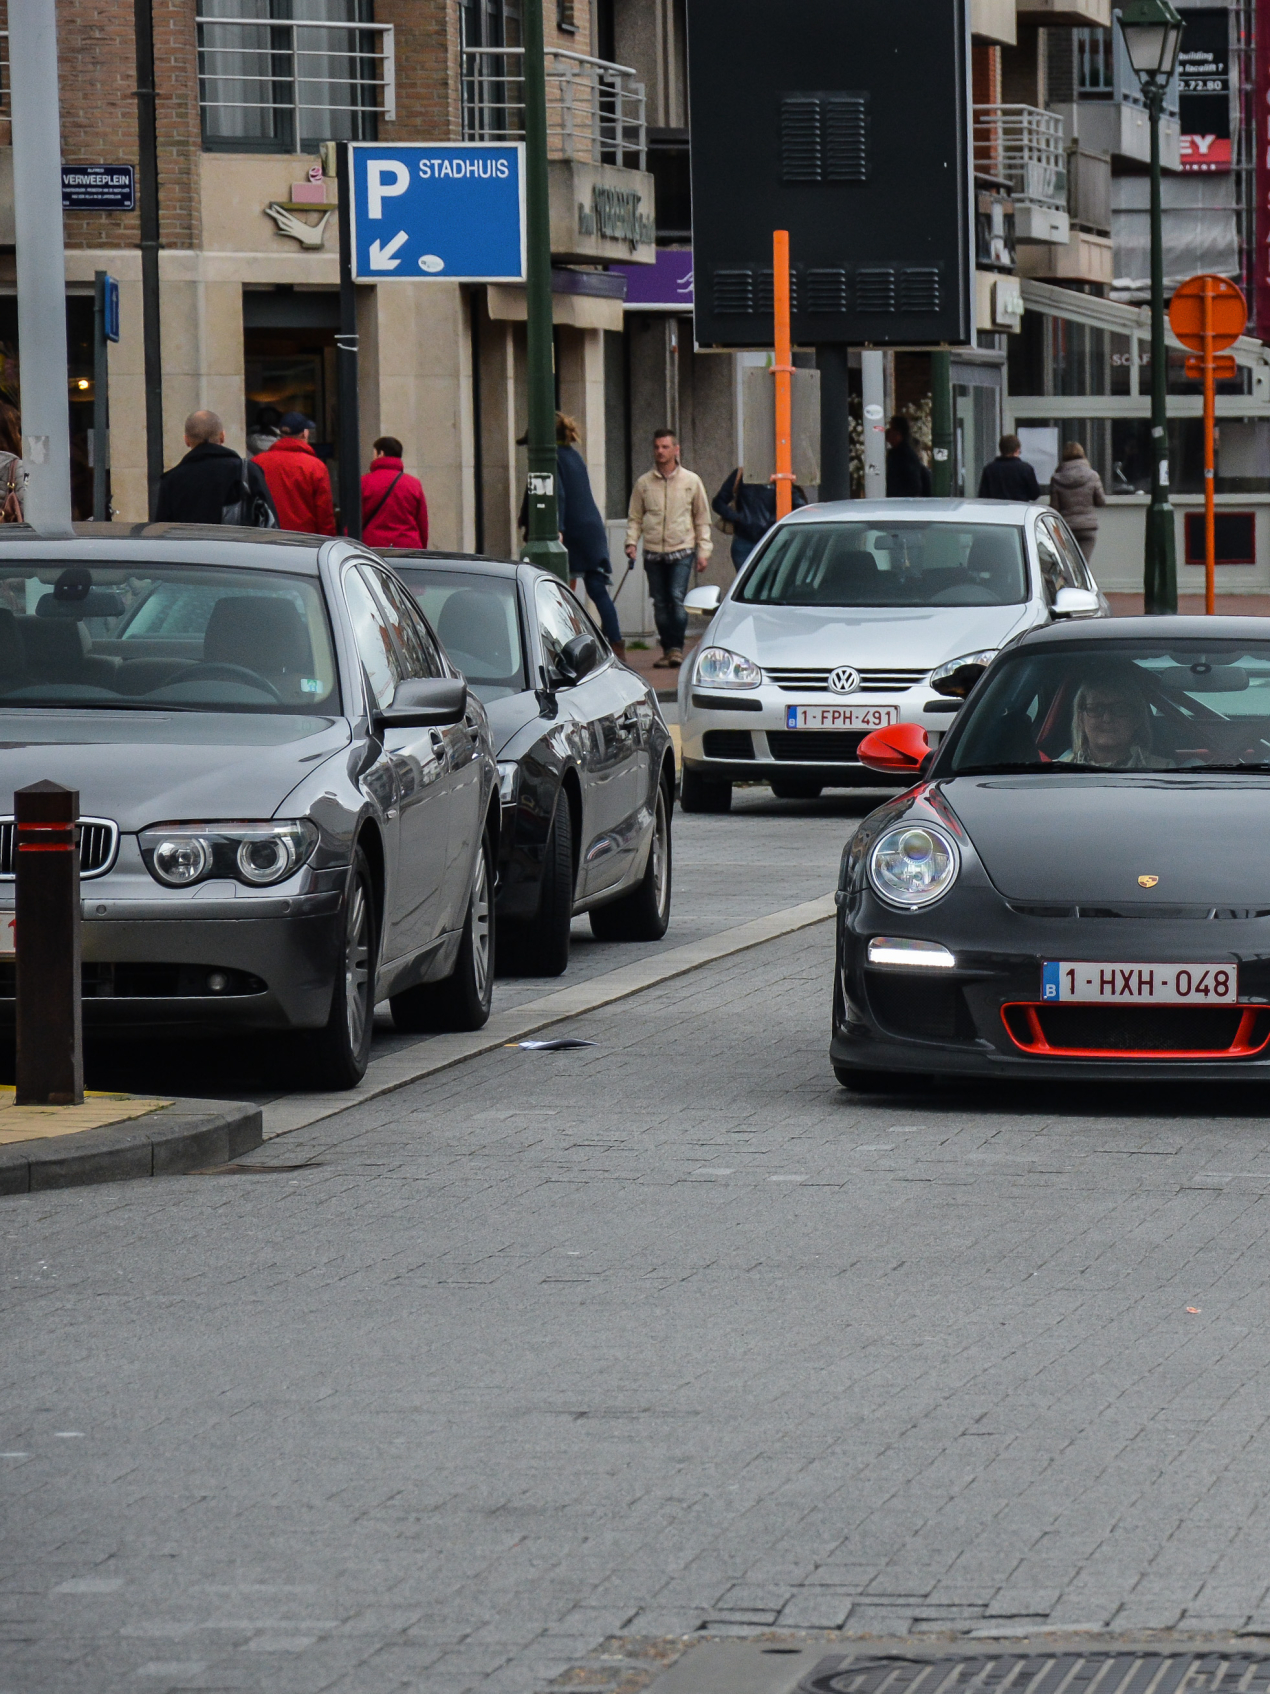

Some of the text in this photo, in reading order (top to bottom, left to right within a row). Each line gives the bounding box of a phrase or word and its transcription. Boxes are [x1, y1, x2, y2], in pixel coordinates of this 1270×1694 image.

[1179, 134, 1216, 154] EY
[63, 175, 130, 186] VERWEEPLEIN
[367, 159, 509, 219] P STADHUIS
[801, 710, 892, 727] 1-FPH-491
[1046, 968, 1230, 997] B 1-HXH-048
